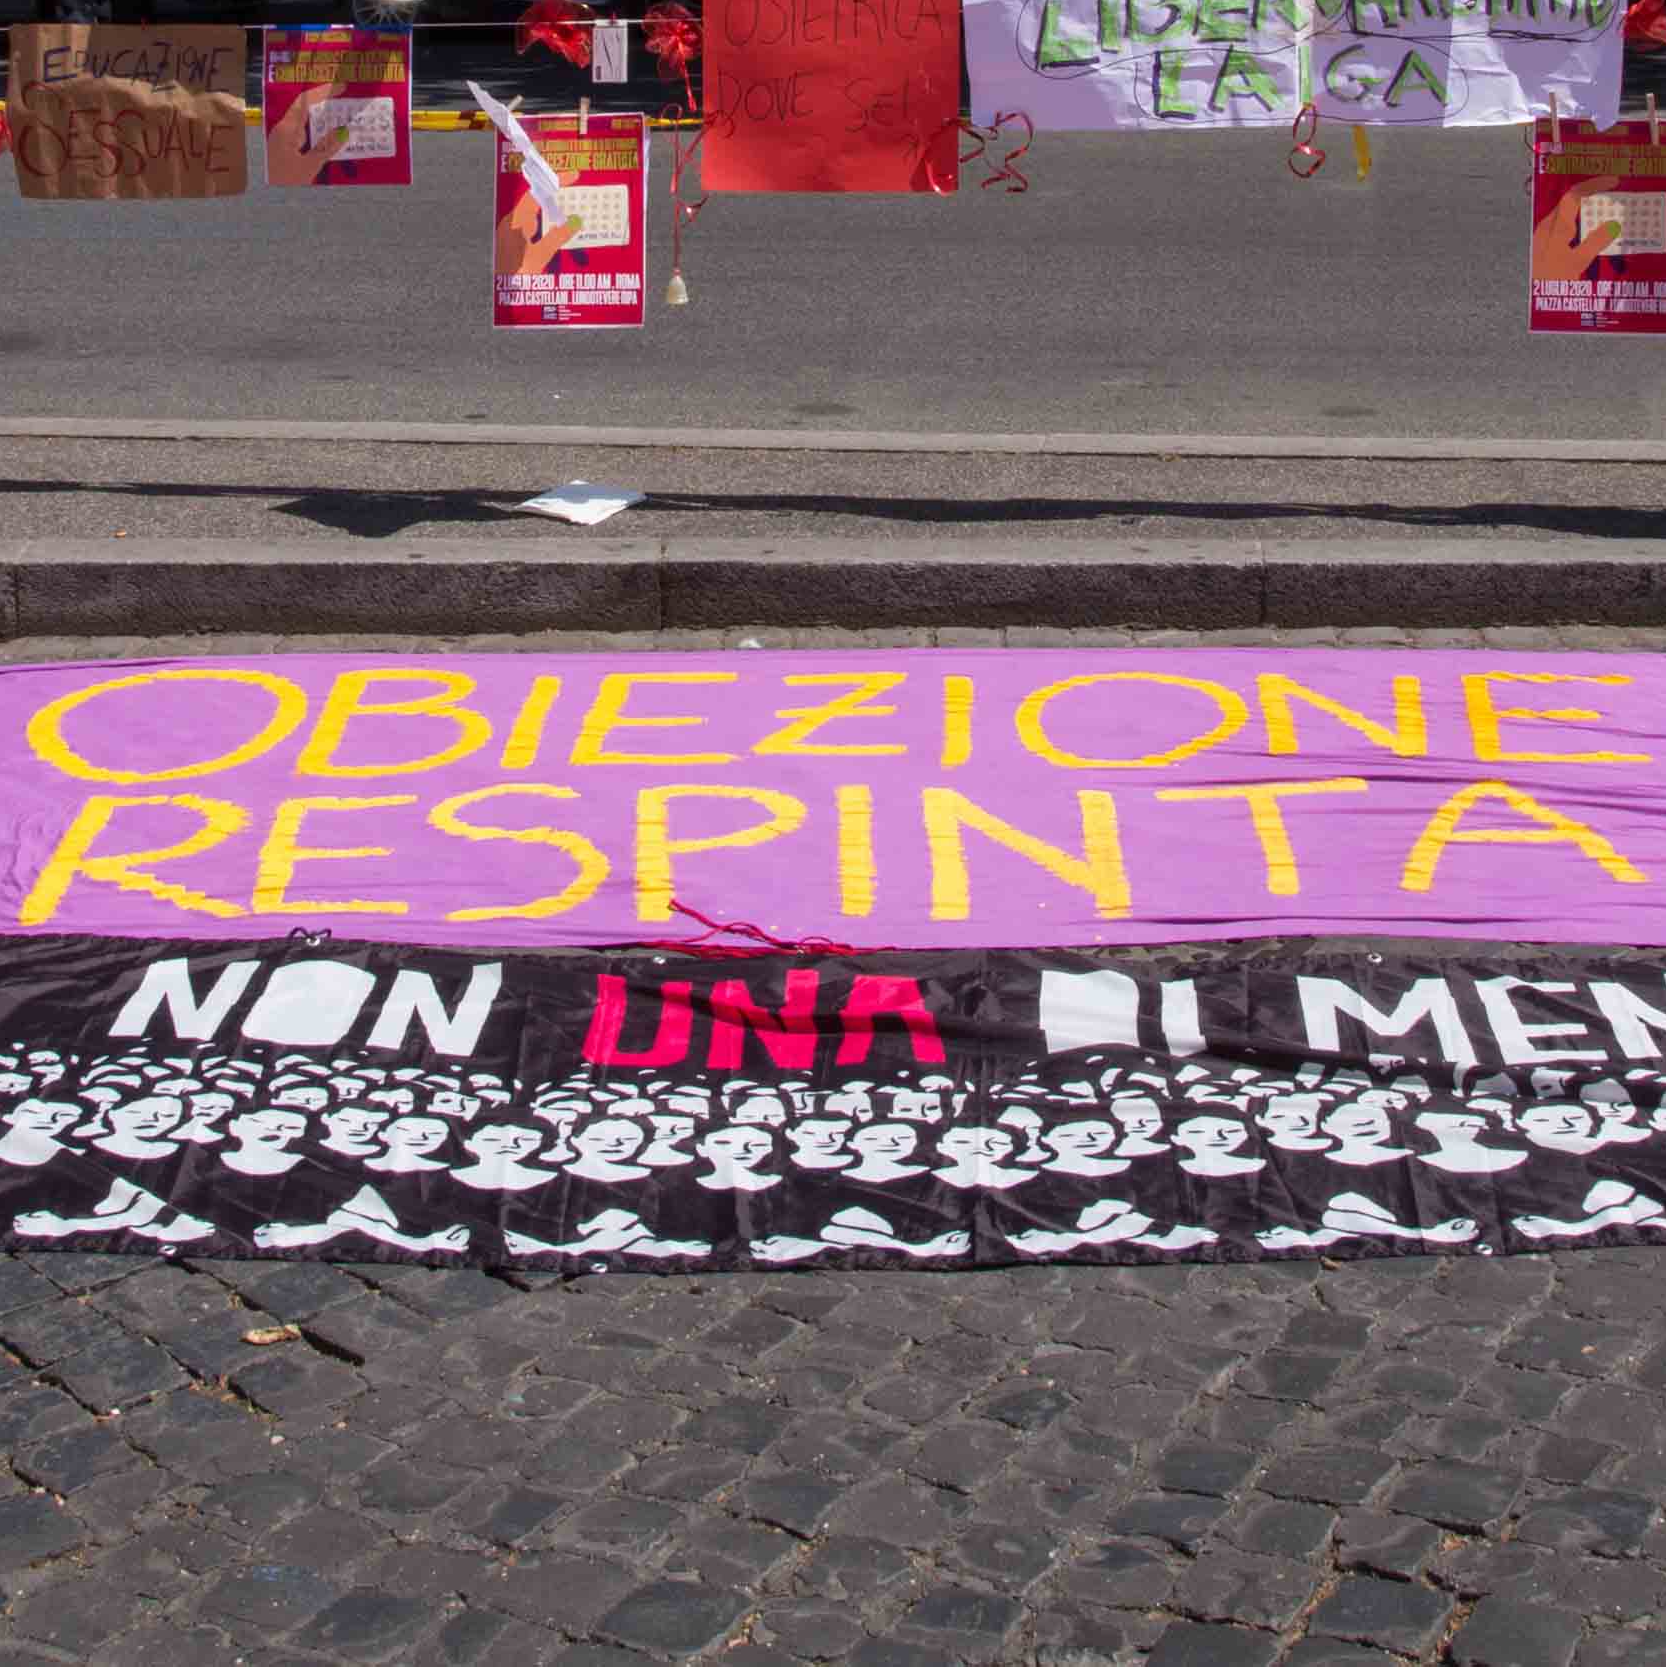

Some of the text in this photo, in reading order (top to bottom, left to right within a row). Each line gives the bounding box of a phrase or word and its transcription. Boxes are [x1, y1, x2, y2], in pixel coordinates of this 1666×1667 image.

[29, 668, 1653, 783] OBIEZIONE
[18, 779, 1650, 927] RESPINTA
[108, 958, 502, 1057] NON
[579, 968, 947, 1070] UNA
[1040, 969, 1206, 1055] DI
